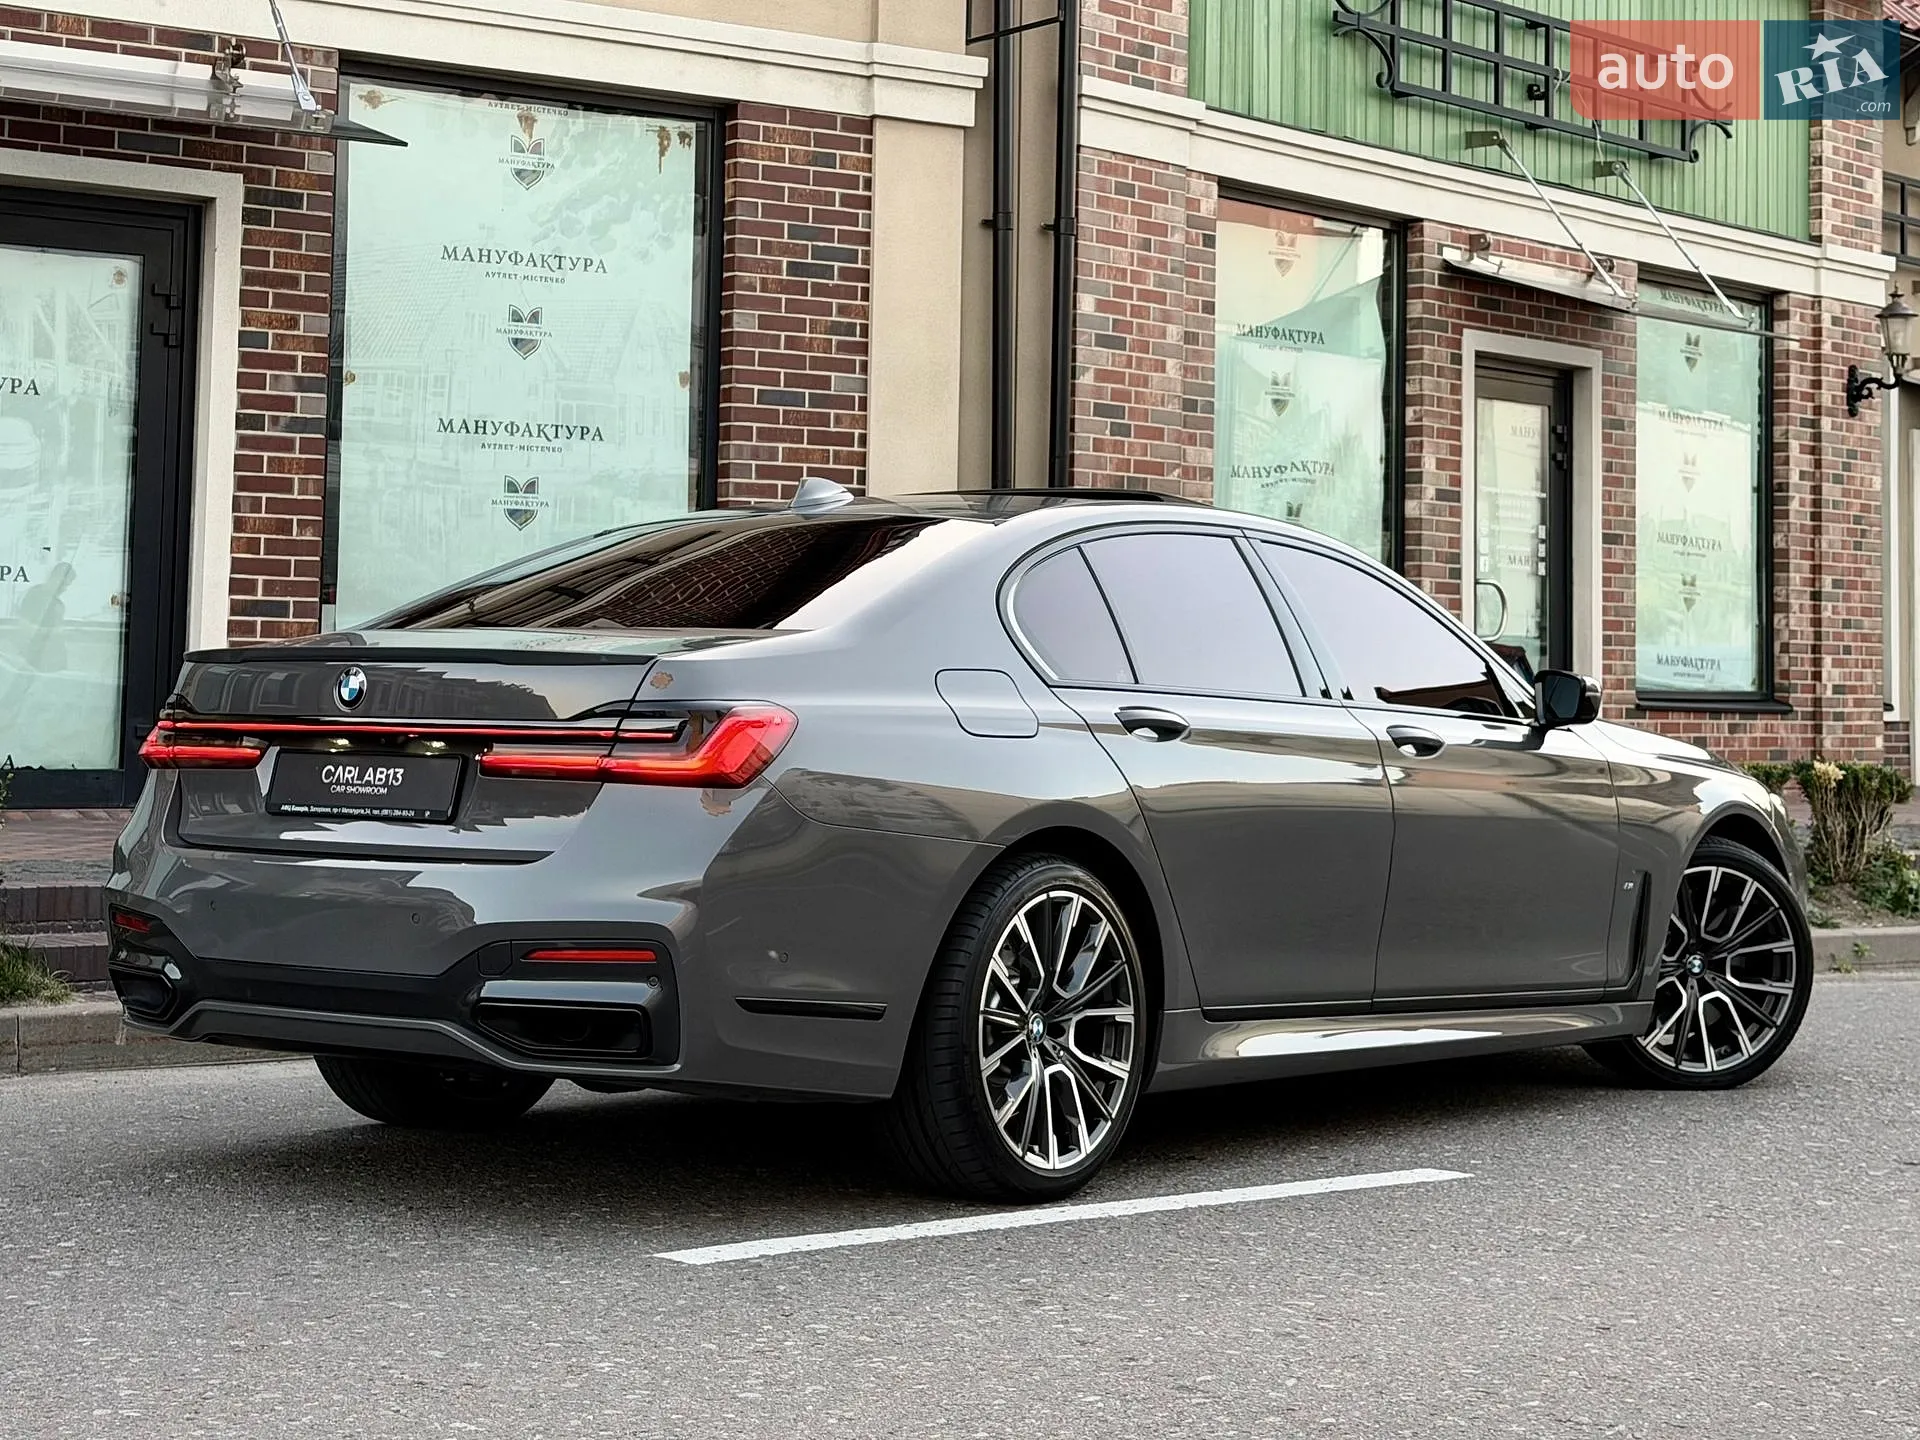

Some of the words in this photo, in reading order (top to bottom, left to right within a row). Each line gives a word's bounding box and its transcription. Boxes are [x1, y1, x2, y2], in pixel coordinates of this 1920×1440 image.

[441, 245, 608, 275] МАНУФАКТУРА
[496, 327, 553, 338] МАНУФАКТУРА
[1236, 323, 1326, 345] МАНУФАКТУРА
[437, 417, 605, 442] МАНУФАКТУРА
[1230, 460, 1335, 479] МАНУФАКТУРА
[491, 498, 550, 508] МАНУФАКТУРА
[321, 764, 405, 786] CARLAB13
[330, 784, 346, 794] CAR
[346, 786, 388, 796] SHOWROOM
